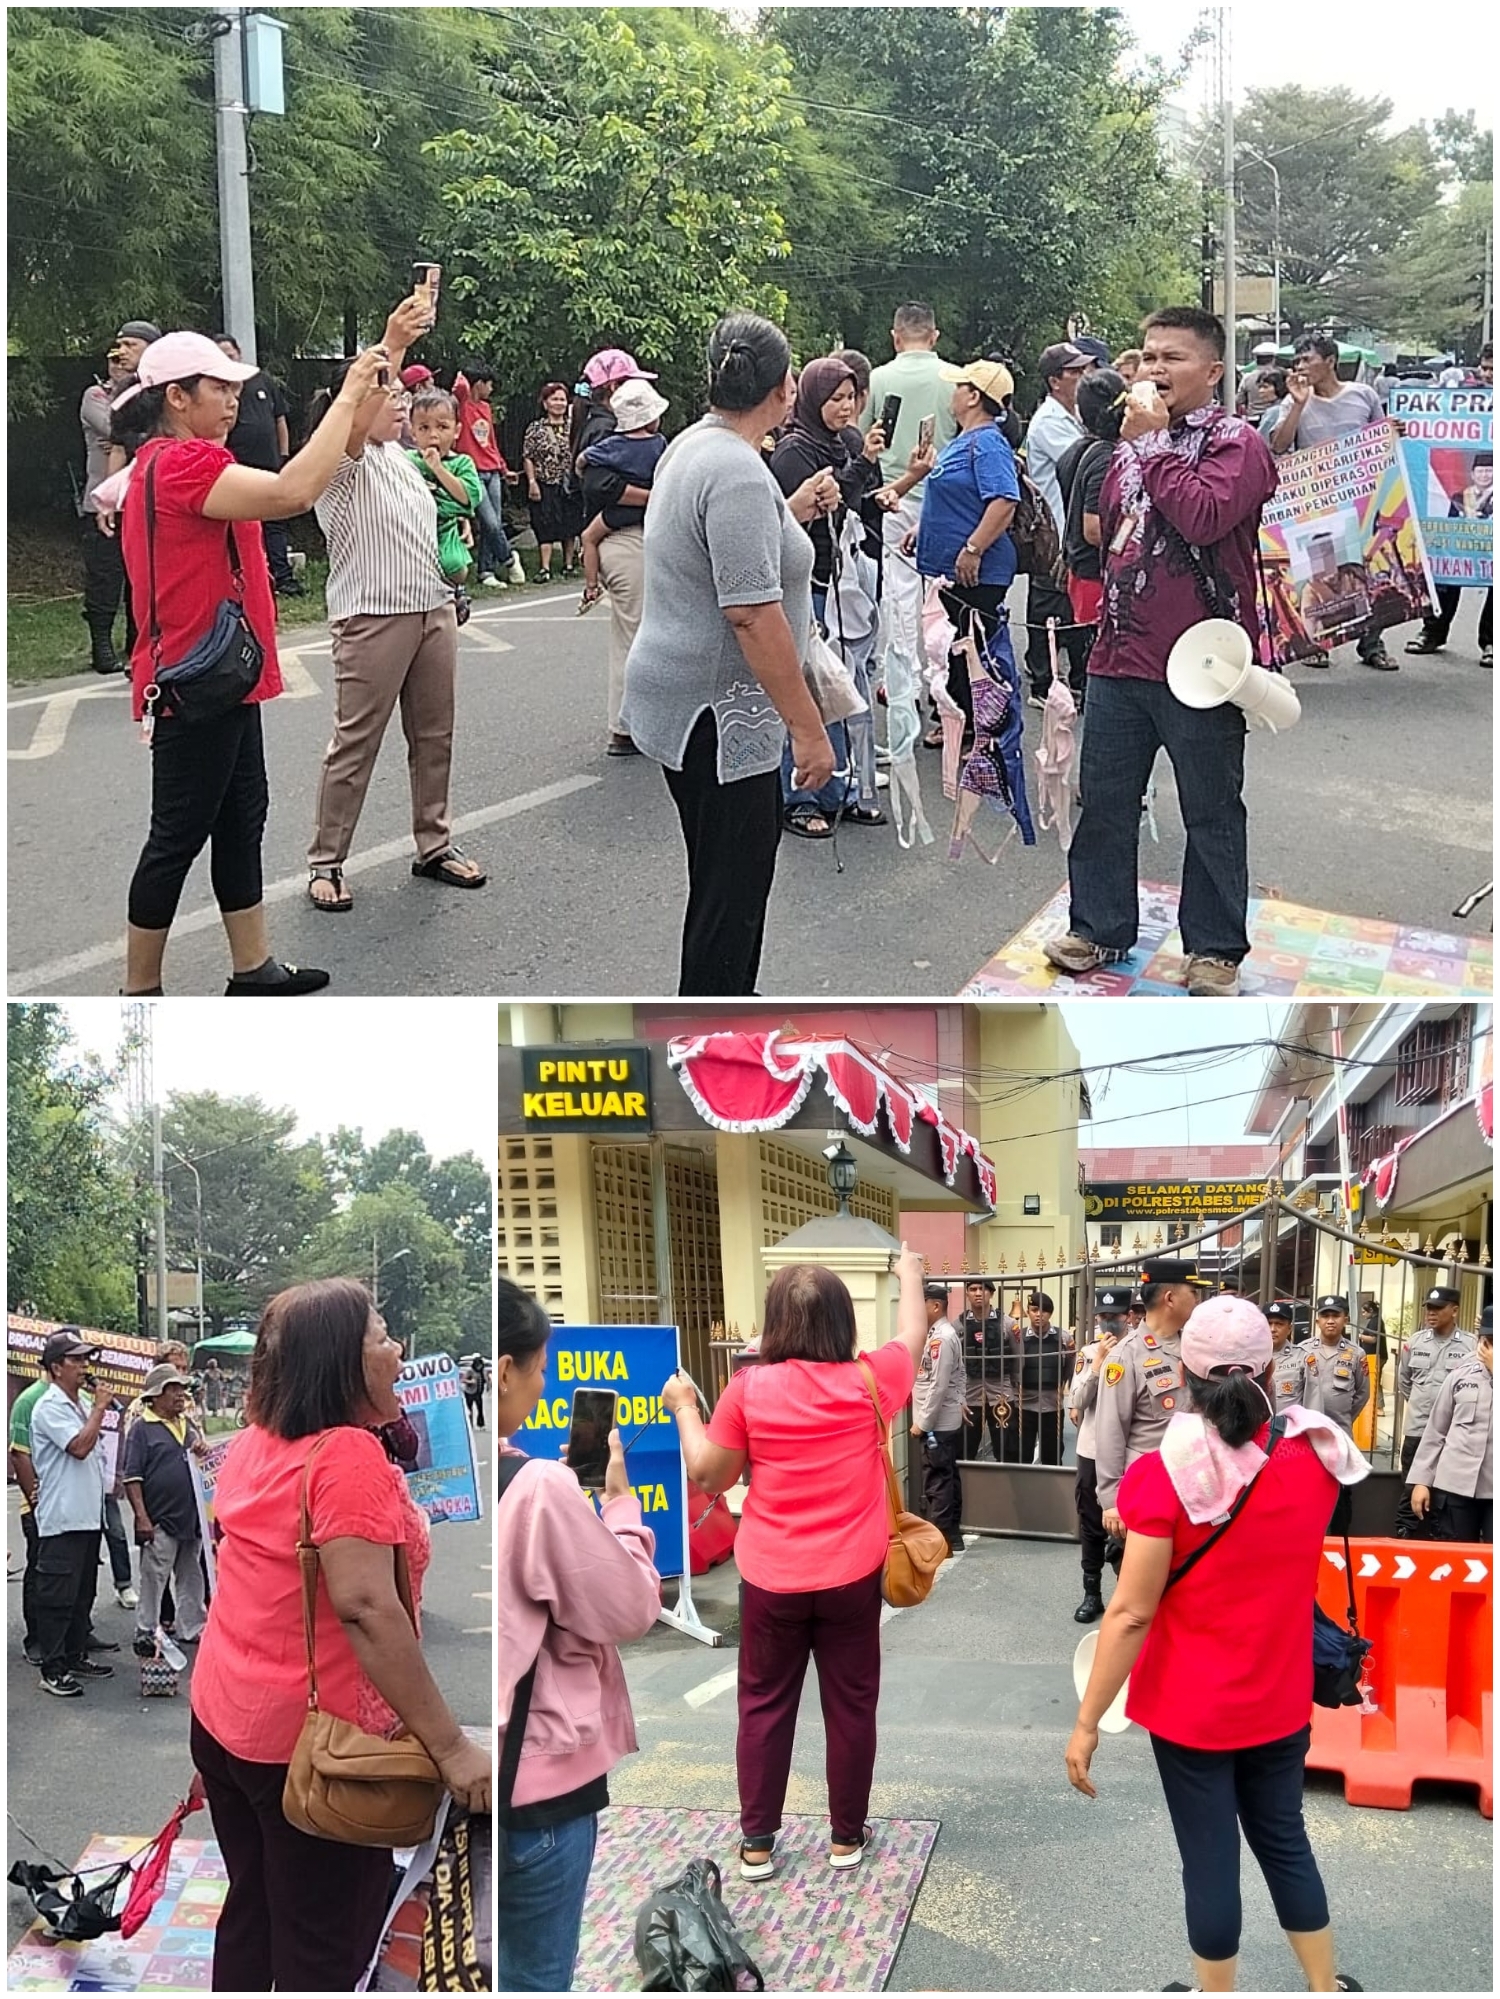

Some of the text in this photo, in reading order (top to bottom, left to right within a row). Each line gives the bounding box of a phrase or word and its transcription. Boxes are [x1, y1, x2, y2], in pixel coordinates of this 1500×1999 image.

[1396, 394, 1442, 412] PAK
[1344, 424, 1390, 449] MALING
[1407, 420, 1480, 439] OLONG
[1282, 469, 1314, 485] BUAT
[1311, 468, 1365, 492] DIPERAS
[1261, 480, 1377, 526] ORBAN PENCURIAN
[539, 1060, 628, 1083] PINTU
[523, 1091, 647, 1117] KELUAR
[1104, 1197, 1120, 1208] DI
[1122, 1195, 1234, 1208] POLRESTABES
[1127, 1184, 1200, 1196] SELAMAT
[81, 1329, 156, 1355] ISURUH
[557, 1350, 629, 1381] BUKA
[517, 1396, 671, 1430] AC OBIL
[436, 1863, 453, 1913] DIA
[460, 1879, 474, 1937] DPR
[440, 1914, 456, 1974] JADI
[462, 1935, 477, 1968] RI
